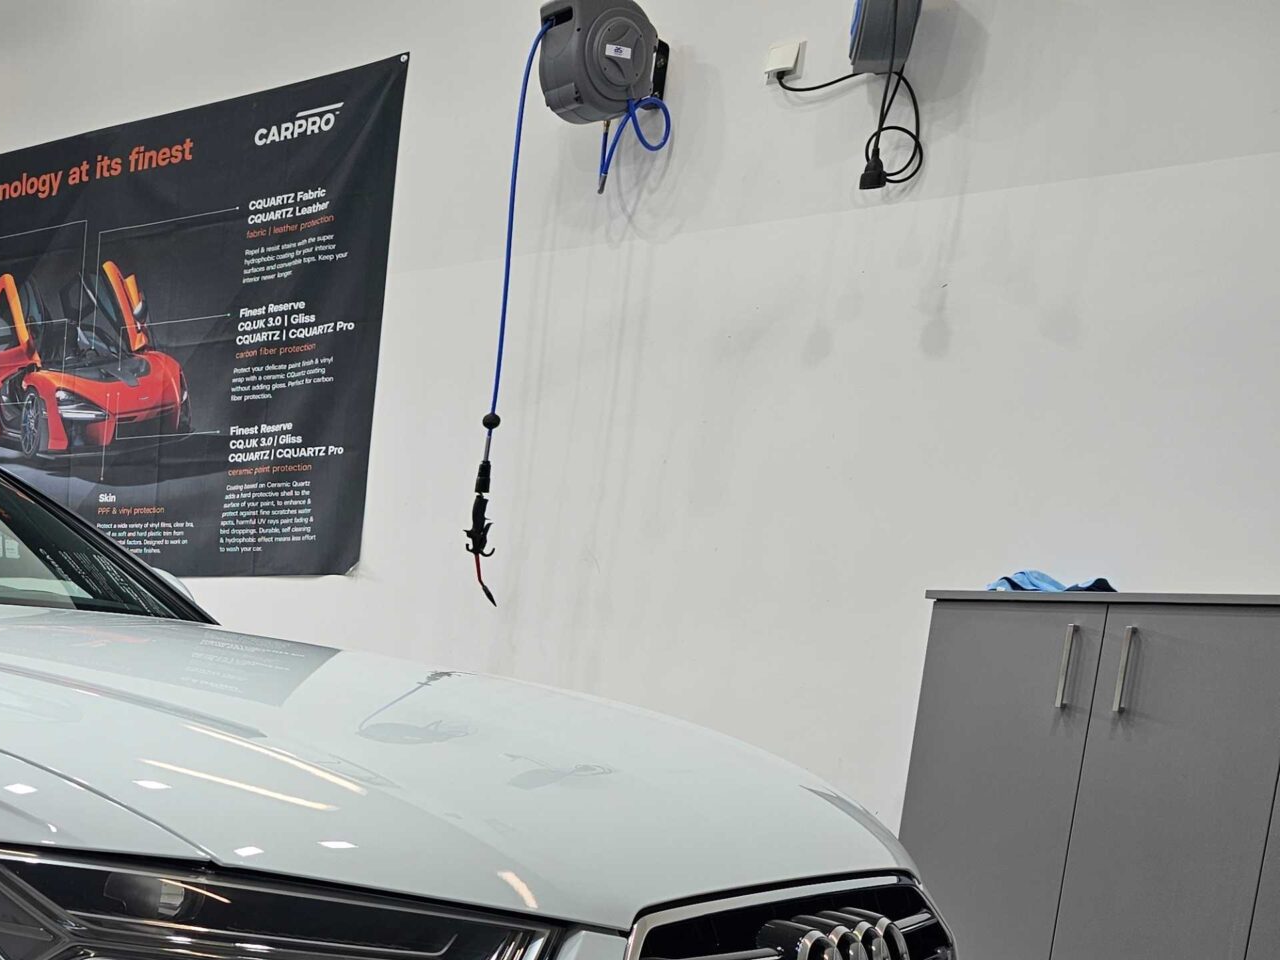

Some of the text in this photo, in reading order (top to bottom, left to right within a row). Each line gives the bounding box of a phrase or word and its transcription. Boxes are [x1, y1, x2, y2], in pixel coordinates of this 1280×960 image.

[254, 112, 336, 146] CARPRO
[68, 161, 89, 186] at
[95, 154, 122, 179] its
[128, 137, 194, 173] finest
[249, 188, 326, 210] CQUARTZ Fabric
[248, 201, 330, 224] CQUARTZ Leather
[246, 215, 334, 238] fabric leather protection
[244, 255, 275, 265] hydrophobic
[302, 247, 314, 255] your
[335, 252, 348, 260] your
[239, 302, 306, 318] Finest Reserve
[238, 314, 316, 331] CQ.UK 3.0 Gliss
[236, 321, 355, 345] CQUARTZ CQUARTZ Pro
[236, 350, 258, 358] carbon
[280, 344, 316, 355] protection
[230, 423, 293, 435] Finest Reserve
[229, 434, 302, 449] CQ.UK 3.0 Gliss
[228, 446, 344, 462] CQUARTZ CQUARTZ Pro
[228, 464, 312, 476] ceramic paint protection
[99, 493, 116, 502] Skin
[252, 491, 279, 499] protective
[119, 507, 132, 515] vinyl
[134, 507, 164, 515] protection
